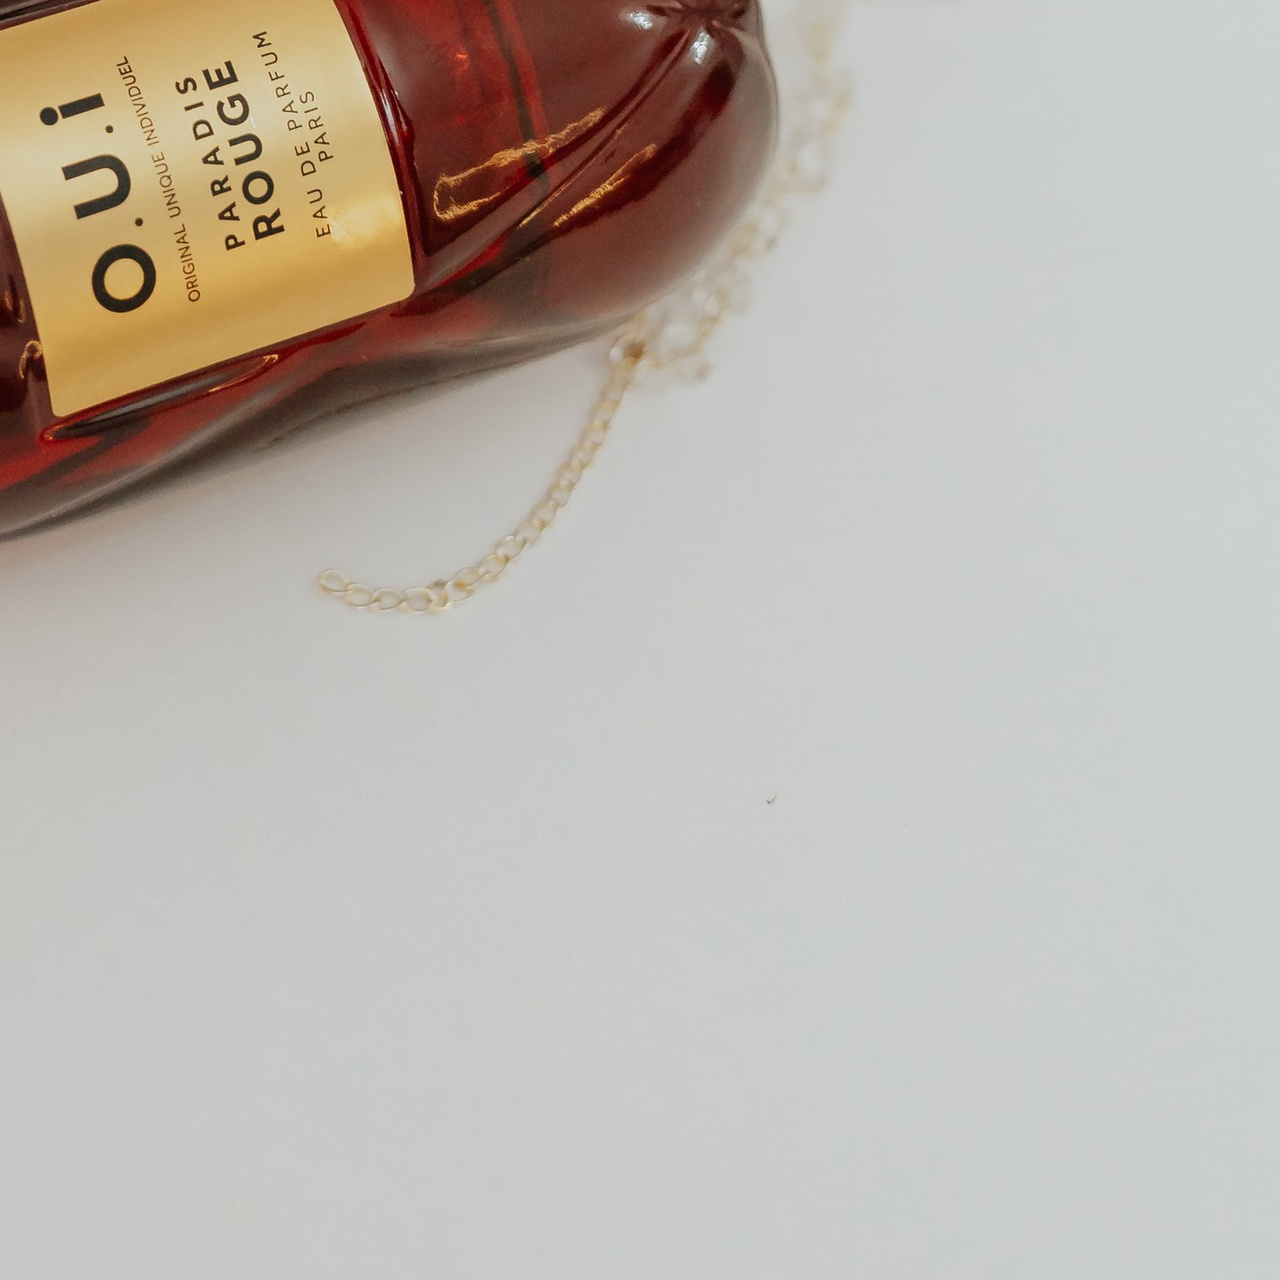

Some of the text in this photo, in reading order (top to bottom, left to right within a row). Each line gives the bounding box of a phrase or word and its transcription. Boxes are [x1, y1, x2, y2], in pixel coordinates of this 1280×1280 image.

[116, 55, 201, 303] ORIGINAL UNIQUE INDIVIDUEL
[174, 76, 246, 251] PARADIS
[201, 60, 286, 241] ROUGE
[252, 30, 331, 238] EAU DE PARFUM
[299, 91, 334, 163] PARIS
